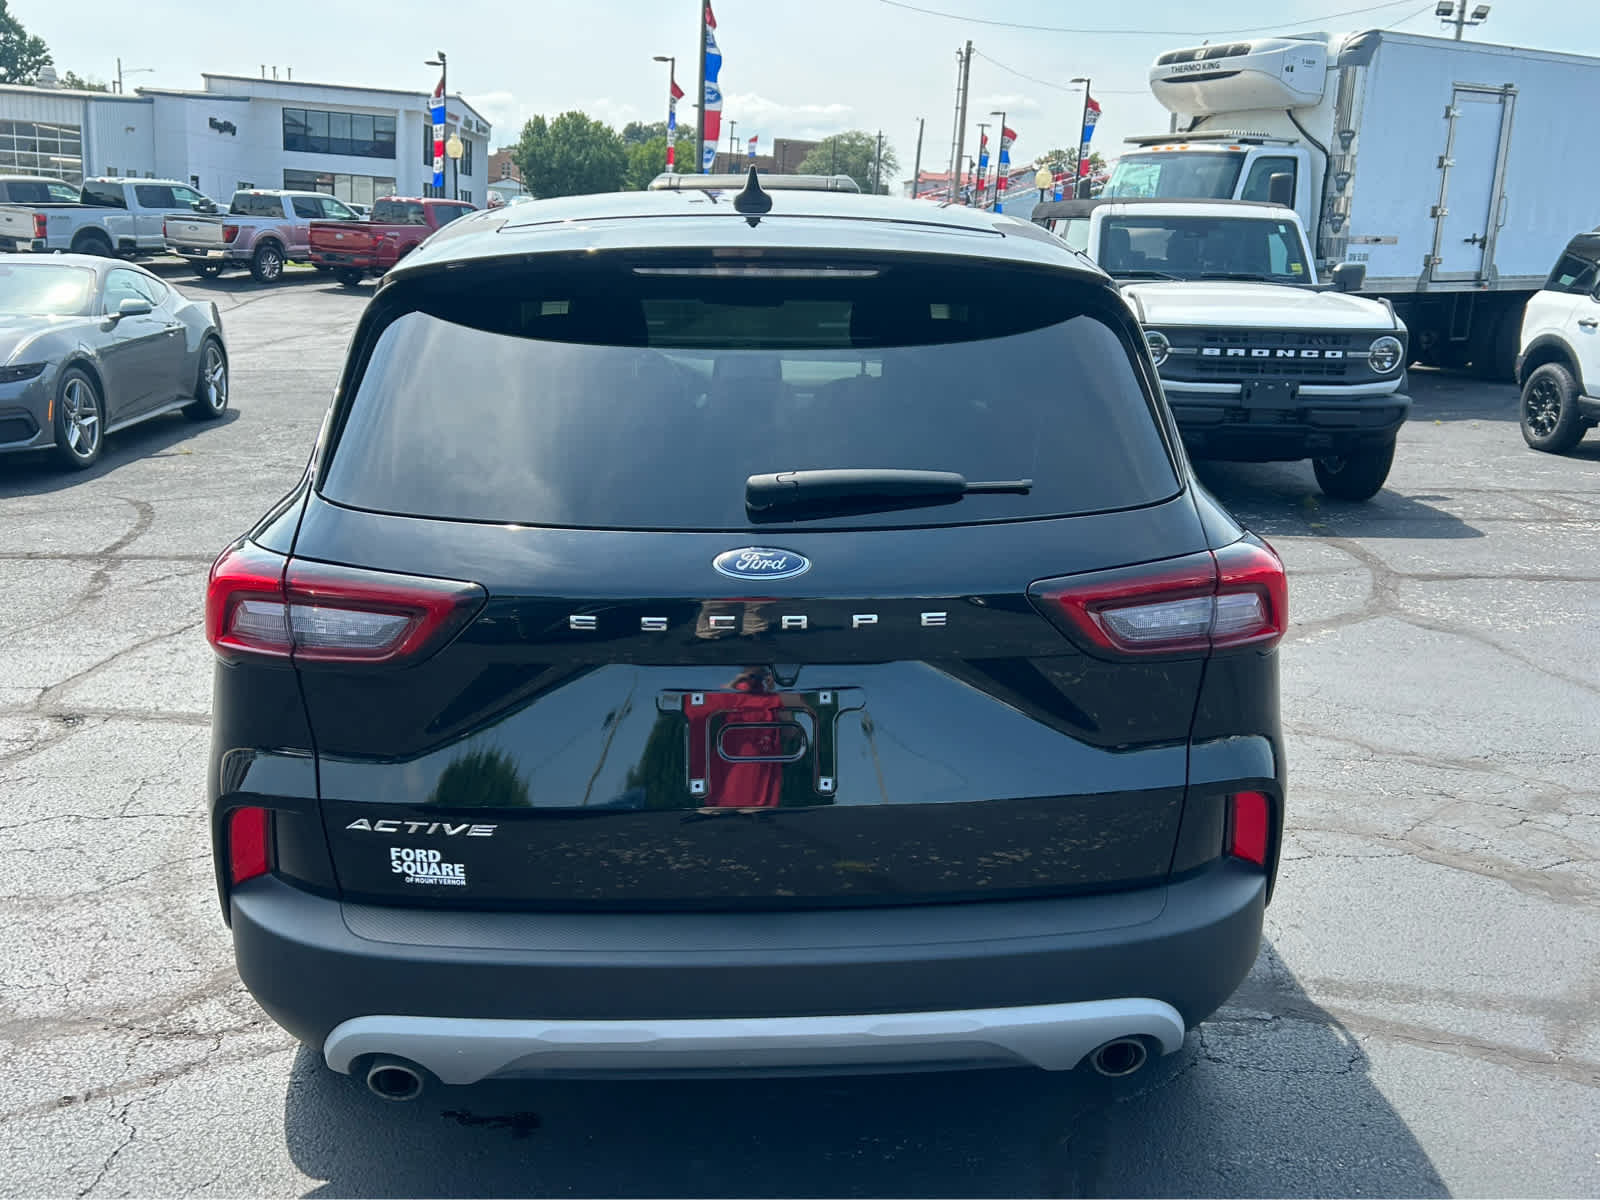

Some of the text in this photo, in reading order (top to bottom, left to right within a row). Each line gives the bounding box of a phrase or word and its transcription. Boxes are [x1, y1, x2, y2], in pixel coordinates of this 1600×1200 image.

[1171, 61, 1221, 73] THERMO KING
[1202, 347, 1343, 358] BRONCO
[736, 551, 787, 570] Ford
[569, 612, 948, 631] ESCAPE
[345, 818, 498, 837] ACTIVE
[390, 847, 441, 862] FORD
[391, 860, 465, 877] SQUARE
[405, 876, 414, 884] OF
